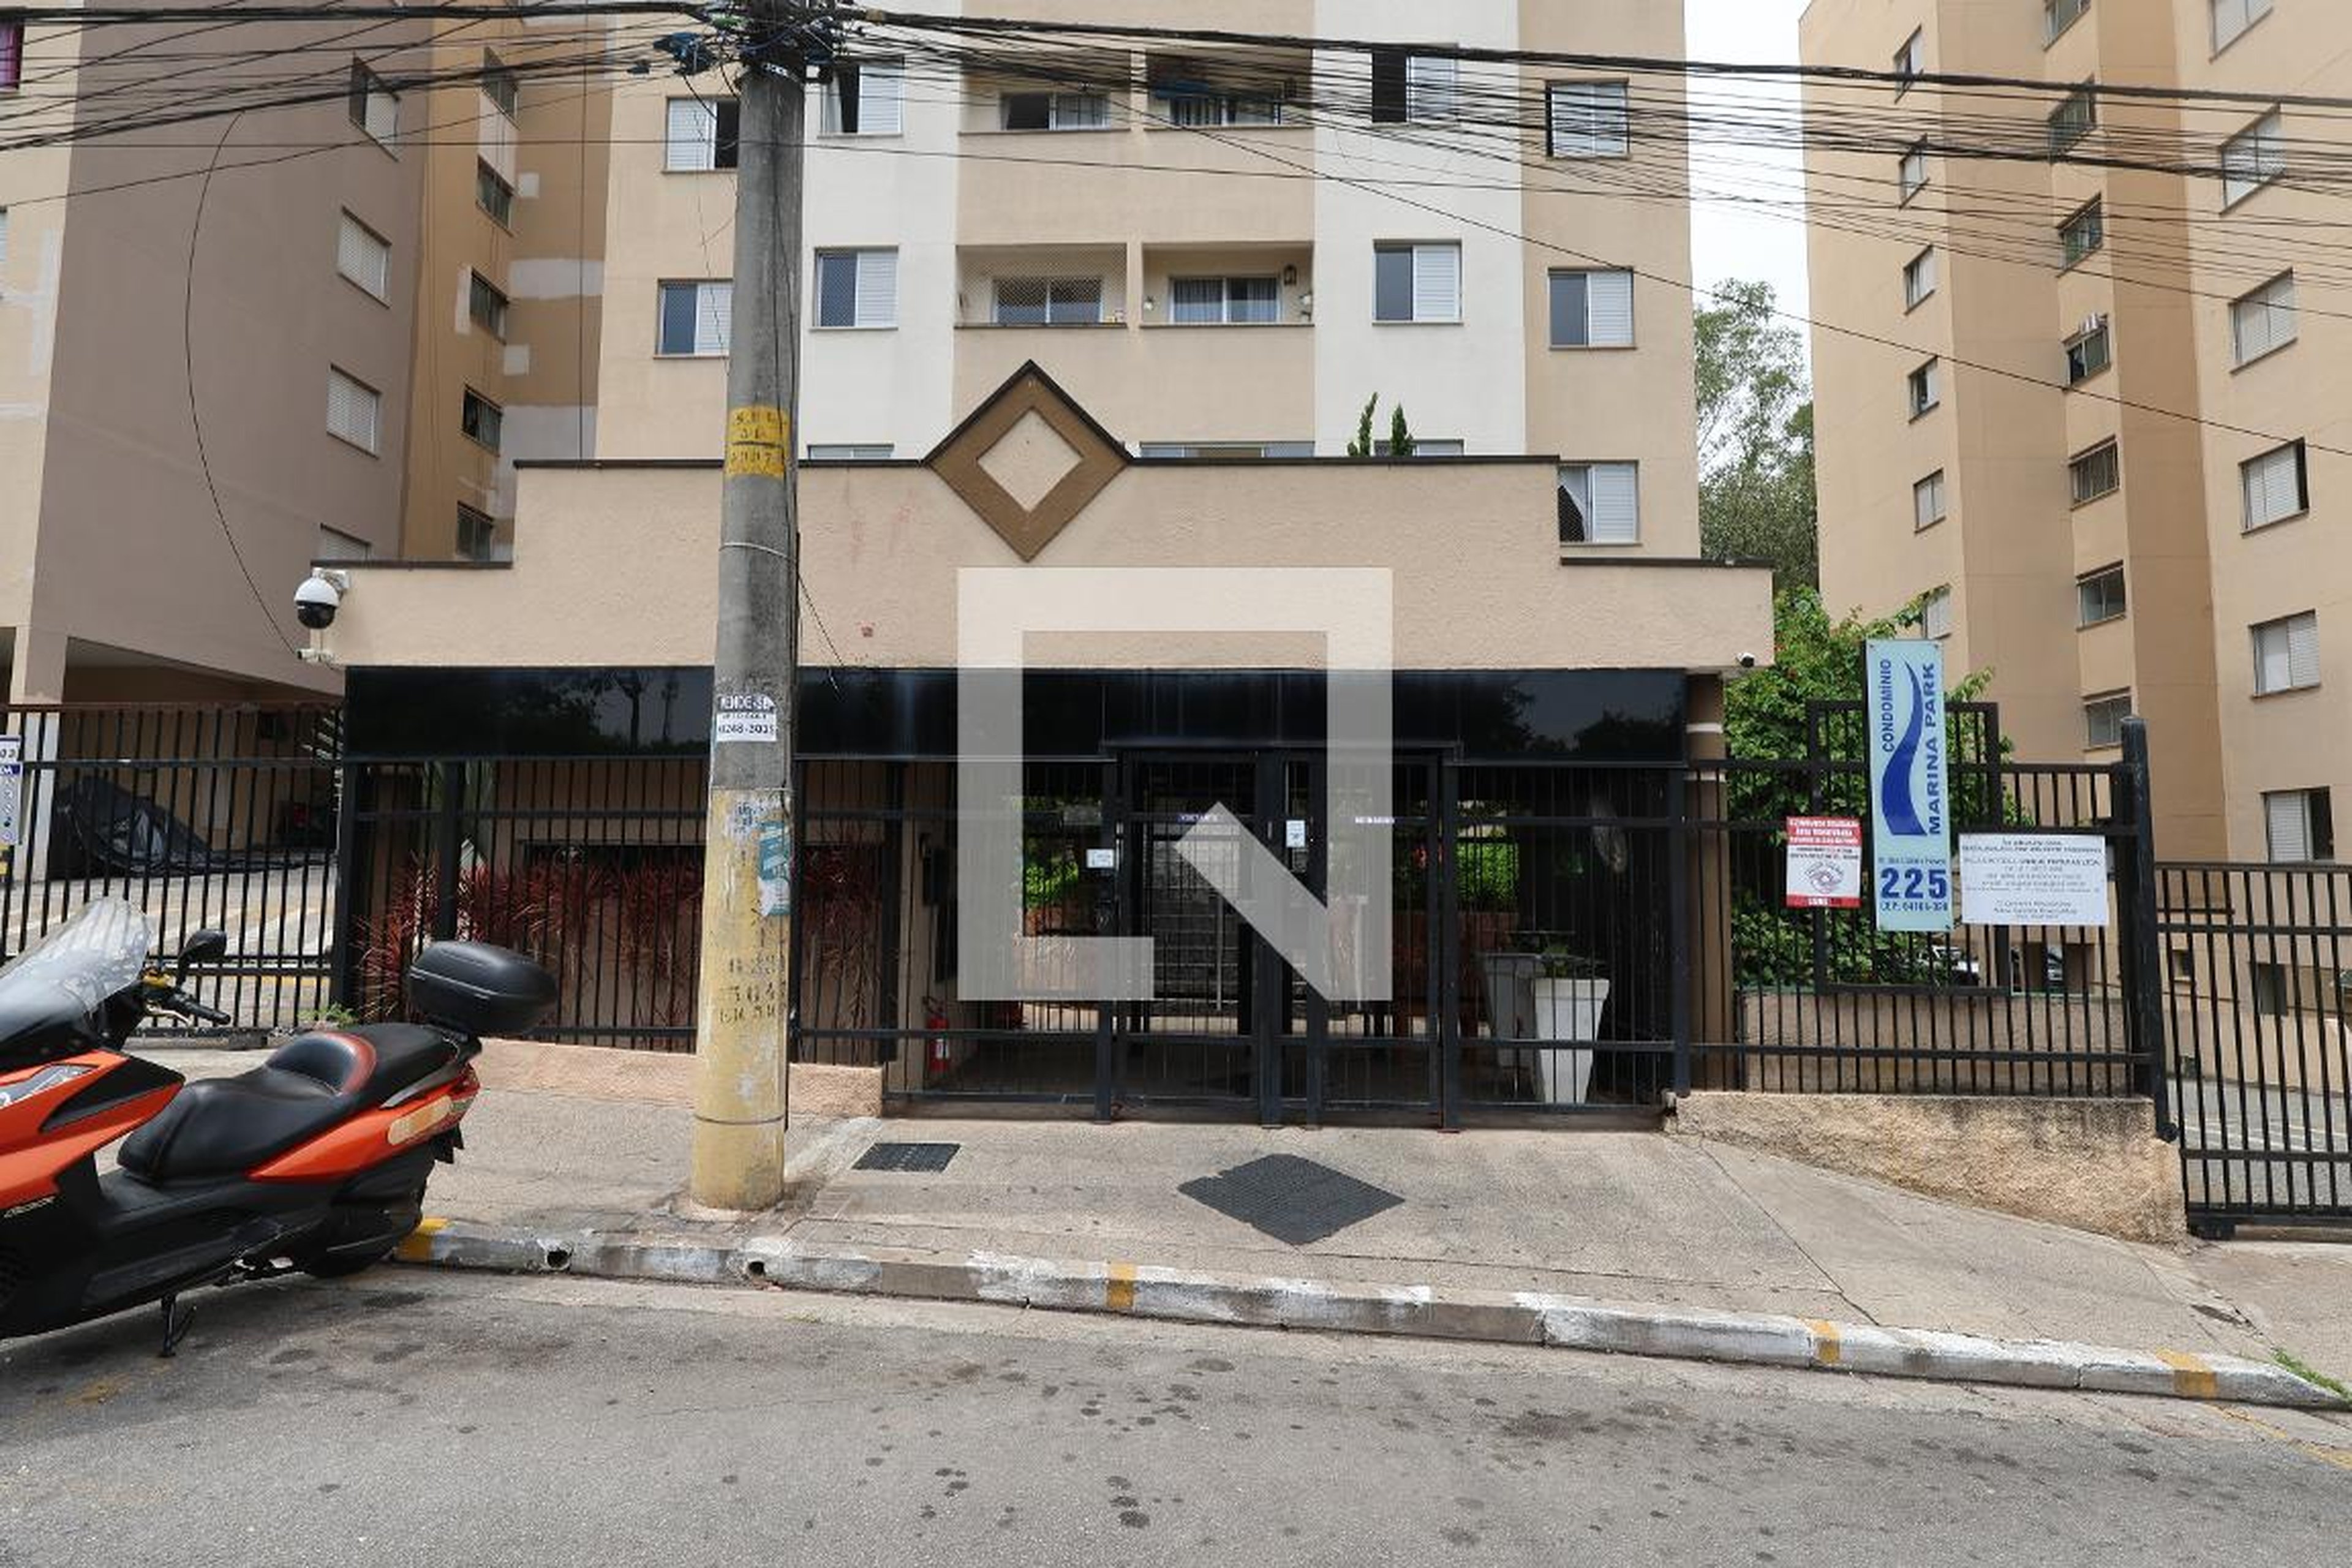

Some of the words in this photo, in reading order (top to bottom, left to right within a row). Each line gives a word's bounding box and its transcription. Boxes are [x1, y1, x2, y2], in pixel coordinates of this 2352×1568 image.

[1923, 663, 1936, 727] PARK
[1926, 737, 1941, 835] MARINA
[1881, 867, 1947, 899] 225
